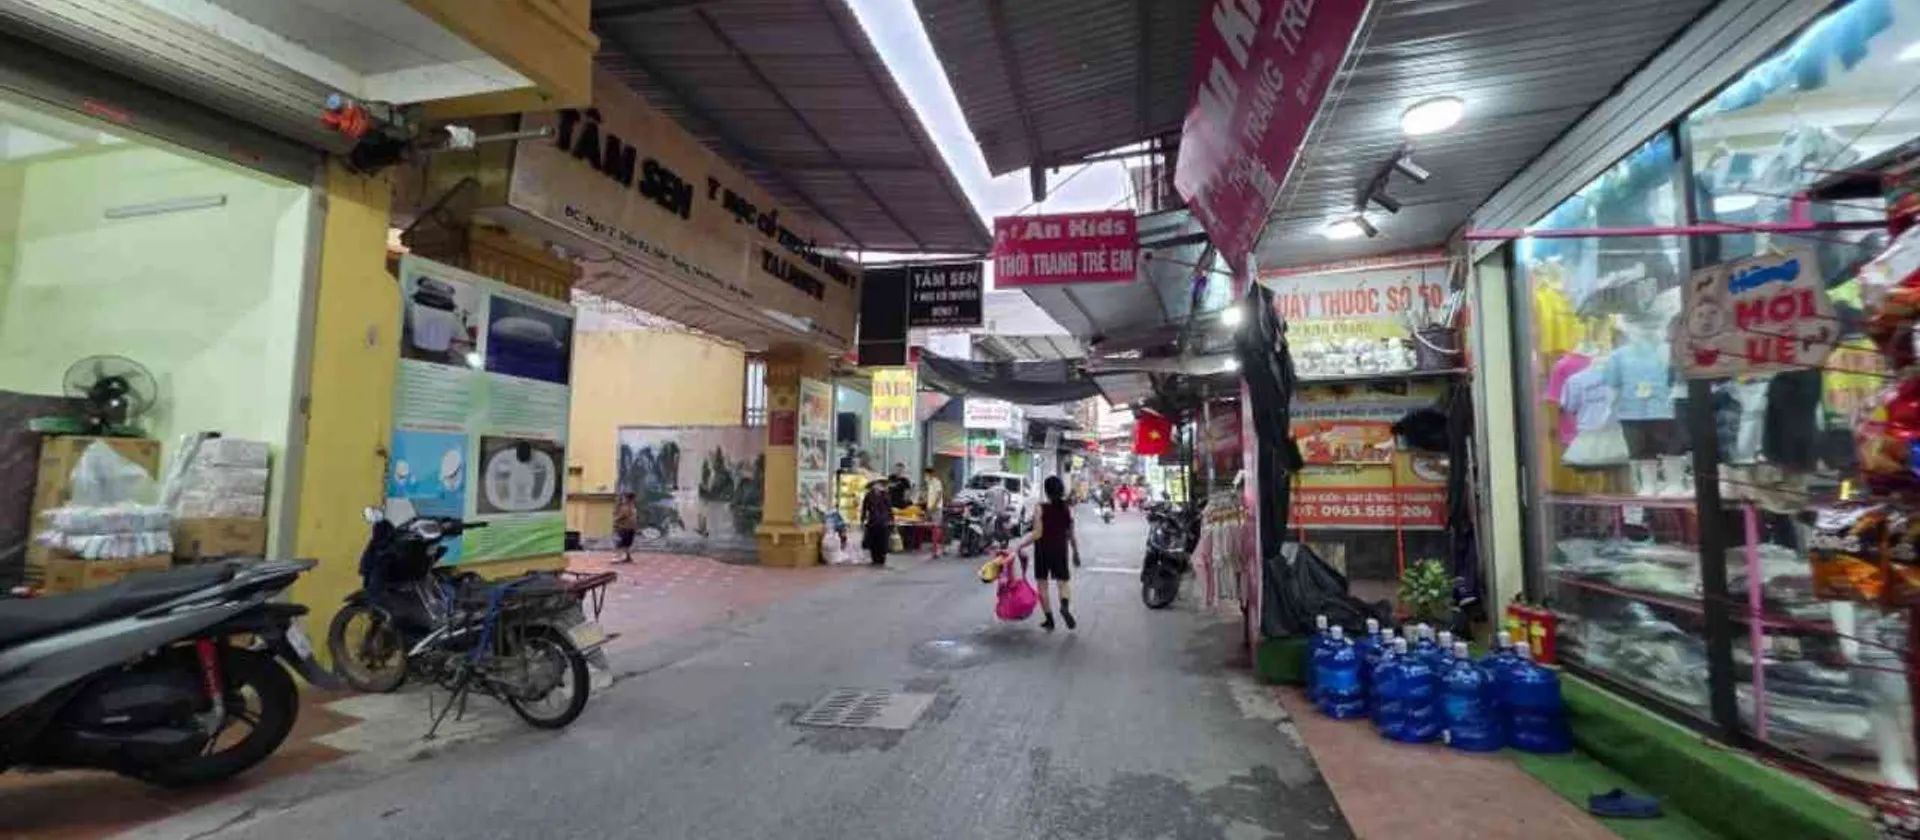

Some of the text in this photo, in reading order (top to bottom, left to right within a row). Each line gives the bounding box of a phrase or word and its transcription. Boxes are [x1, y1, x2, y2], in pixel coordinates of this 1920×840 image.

[1243, 57, 1285, 149] TRANG
[556, 107, 694, 220] TÂM SEN
[1024, 217, 1128, 240] An Kids
[1033, 251, 1078, 277] TRANG
[1083, 243, 1108, 274] TRẺ
[1110, 250, 1133, 272] EM
[914, 269, 978, 289] TÂM SEN
[1318, 277, 1380, 317] THUỐC
